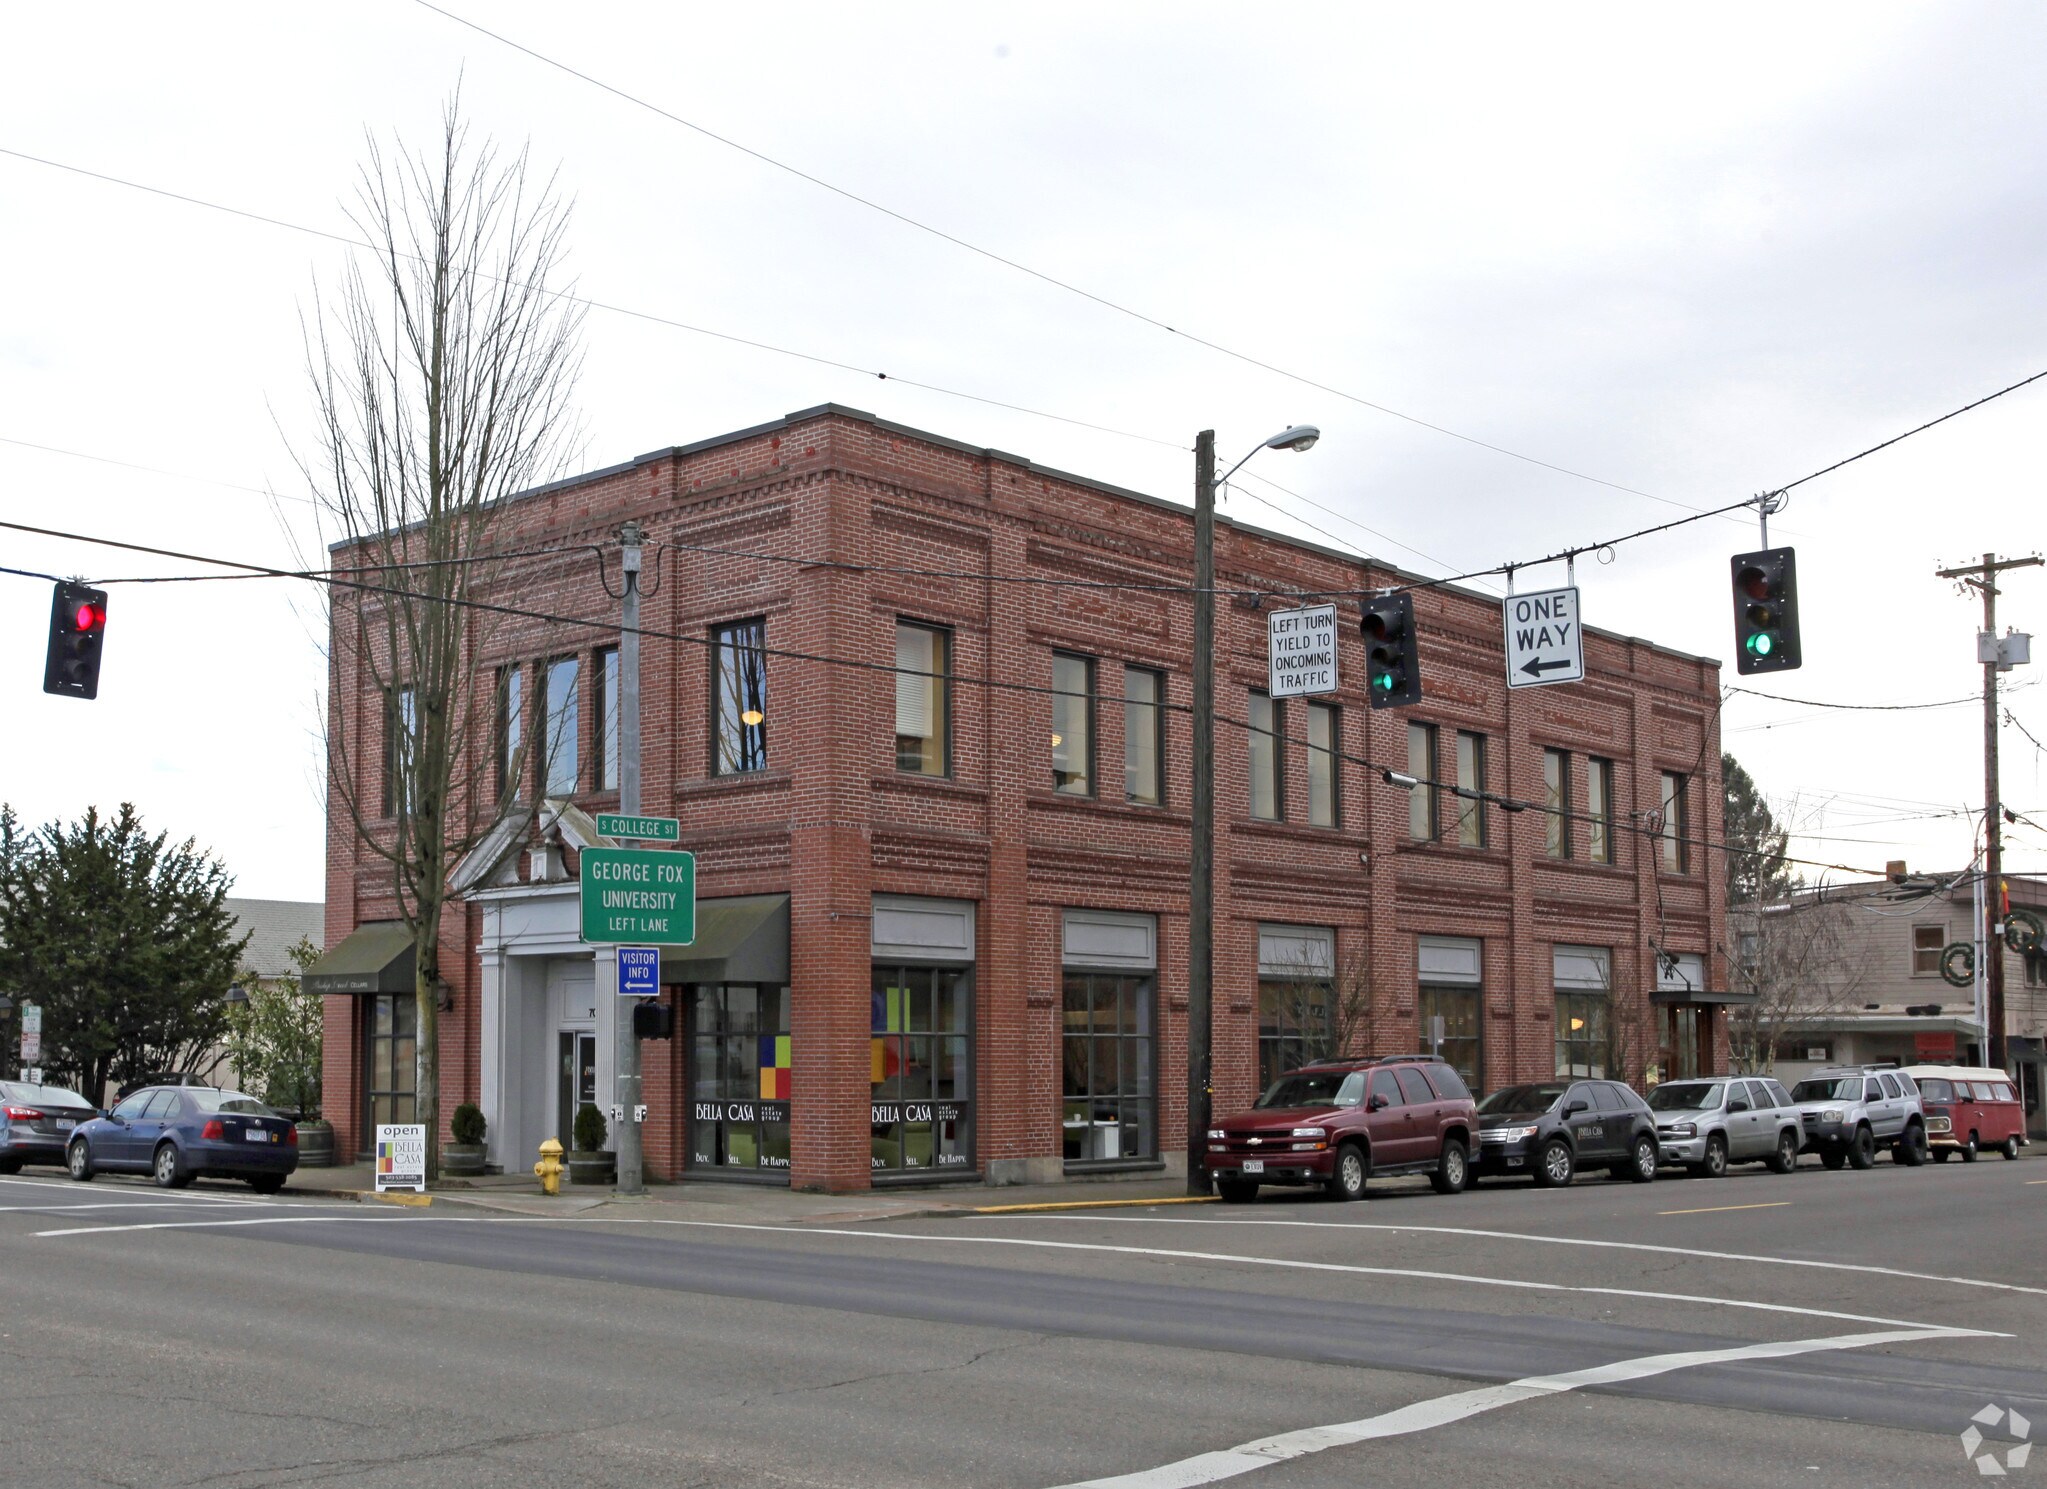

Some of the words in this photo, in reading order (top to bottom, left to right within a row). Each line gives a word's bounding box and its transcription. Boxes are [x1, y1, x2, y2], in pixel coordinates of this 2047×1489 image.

[1516, 595, 1567, 623] ONE
[1273, 616, 1300, 634] LEFT
[1304, 613, 1333, 630] TURN
[1276, 633, 1311, 650] YIELD
[1316, 633, 1331, 648] TO
[1516, 623, 1571, 652] WAY
[1275, 651, 1332, 671] ONCOMING
[1279, 670, 1329, 689] TRAFFIC
[602, 820, 607, 830] S
[611, 819, 660, 836] COLLEGE
[664, 825, 674, 835] ST
[592, 862, 650, 882] GEORGE
[657, 865, 684, 883] FOX
[602, 889, 677, 910] UNIVERSITY
[609, 917, 636, 931] LEFT
[641, 918, 669, 932] LANE
[622, 952, 656, 965] VISITOR
[628, 967, 649, 979] INFO
[696, 1104, 723, 1121] BELLA
[728, 1104, 755, 1122] CASA
[871, 1106, 900, 1123] BELLA
[905, 1104, 932, 1122] CASA
[384, 1127, 419, 1138] open
[395, 1141, 423, 1153] BELLA
[394, 1153, 421, 1165] CASA
